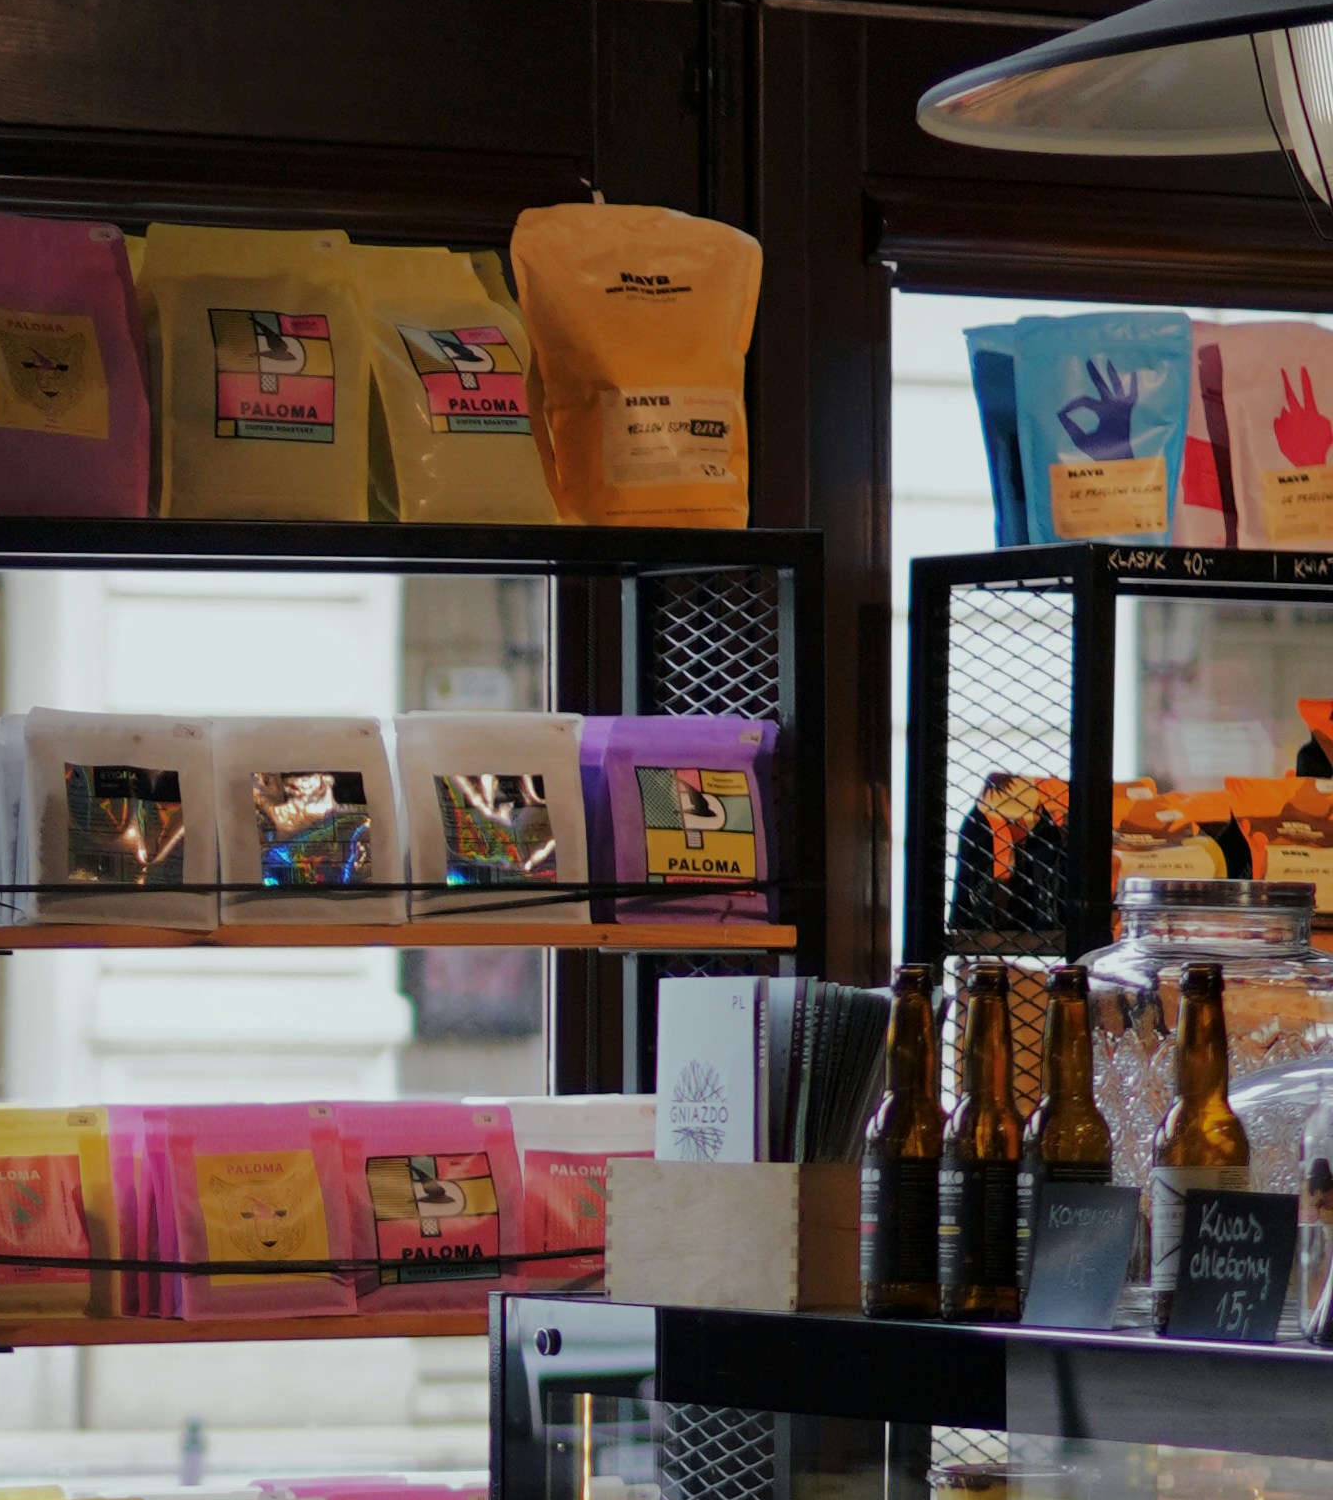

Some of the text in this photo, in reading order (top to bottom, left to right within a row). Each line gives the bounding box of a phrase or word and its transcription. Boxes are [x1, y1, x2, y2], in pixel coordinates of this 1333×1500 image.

[4, 318, 67, 334] PALOMA
[239, 400, 319, 420] PALOMA
[448, 396, 520, 414] PALOMA
[624, 394, 671, 408] HAYB
[1107, 549, 1168, 570] KLASYK
[667, 856, 742, 874] PALOMA
[731, 995, 746, 1010] PL
[758, 999, 767, 1068] GNIAZDO
[669, 1105, 729, 1124] GNIAZDO
[226, 1161, 285, 1176] PALOMA
[401, 1243, 485, 1261] PALOMA
